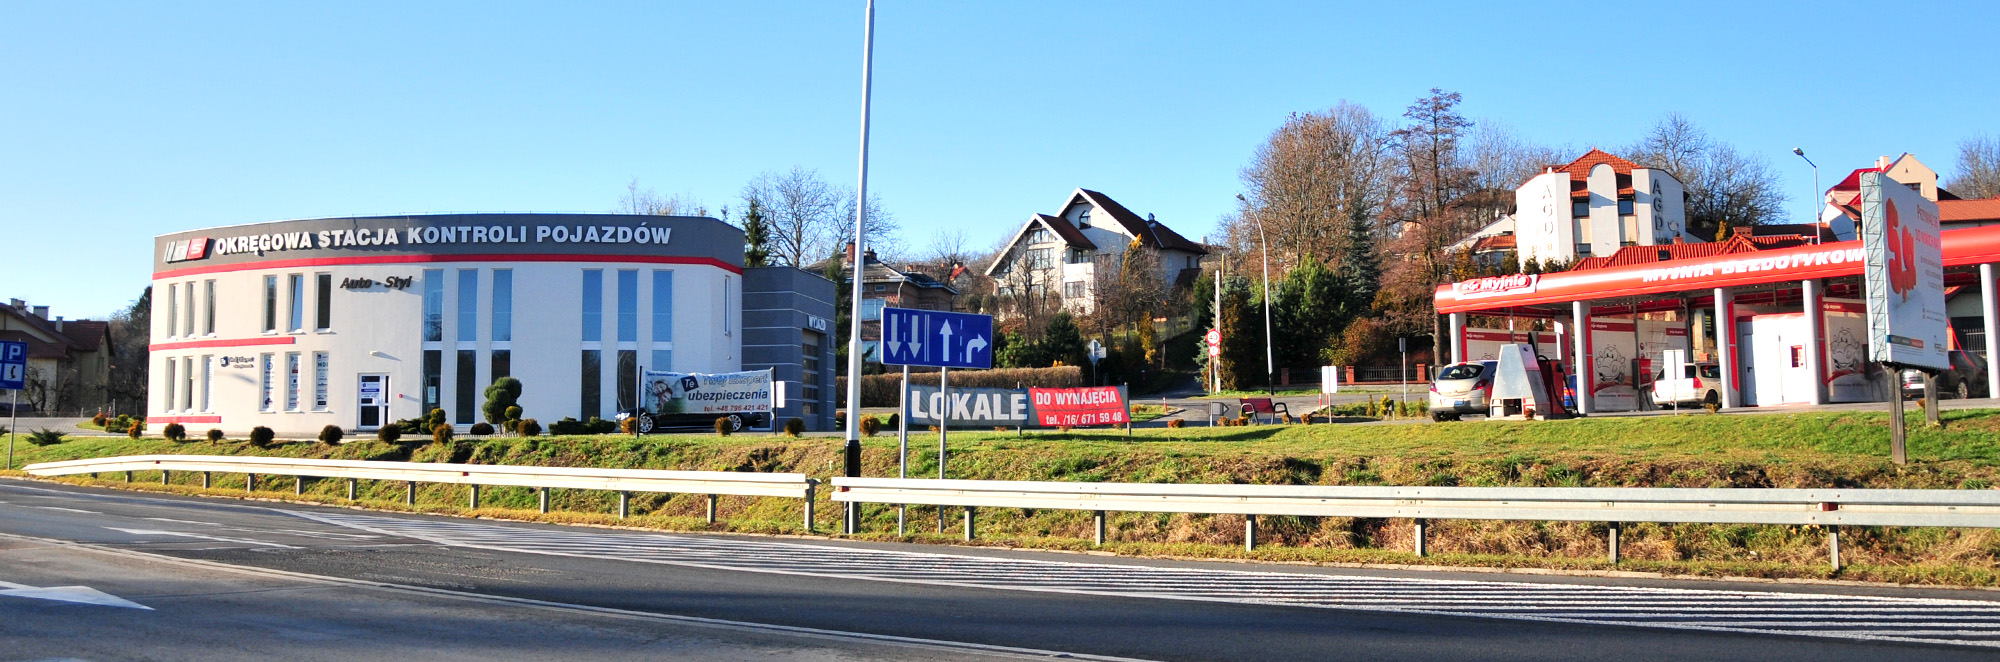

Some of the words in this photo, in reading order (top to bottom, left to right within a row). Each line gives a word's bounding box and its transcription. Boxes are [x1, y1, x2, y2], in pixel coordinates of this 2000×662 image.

[1652, 178, 1663, 231] AGD
[215, 231, 312, 256] OKRĘGOWA
[318, 228, 399, 247] STACJA
[407, 225, 527, 244] KONTROLI
[536, 222, 671, 244] POJAZDÓW
[1642, 263, 1714, 282] MYJNIA
[1721, 248, 1865, 274] BEZDOTYKOW
[339, 276, 373, 289] Auto
[384, 275, 413, 291] Styl
[8, 344, 21, 360] P
[728, 374, 768, 387] Ekspert
[688, 388, 768, 403] ubezpieczenia
[703, 404, 715, 412] tel.
[757, 403, 768, 411] 421
[911, 390, 1028, 421] LOKALE
[1035, 391, 1051, 406] DO
[1054, 390, 1117, 407] WYNAJĘCIA
[1045, 414, 1060, 425] tel.
[1062, 413, 1079, 426] /16/
[1081, 413, 1096, 424] 671
[1099, 412, 1110, 423] 59
[1112, 411, 1123, 422] 48
